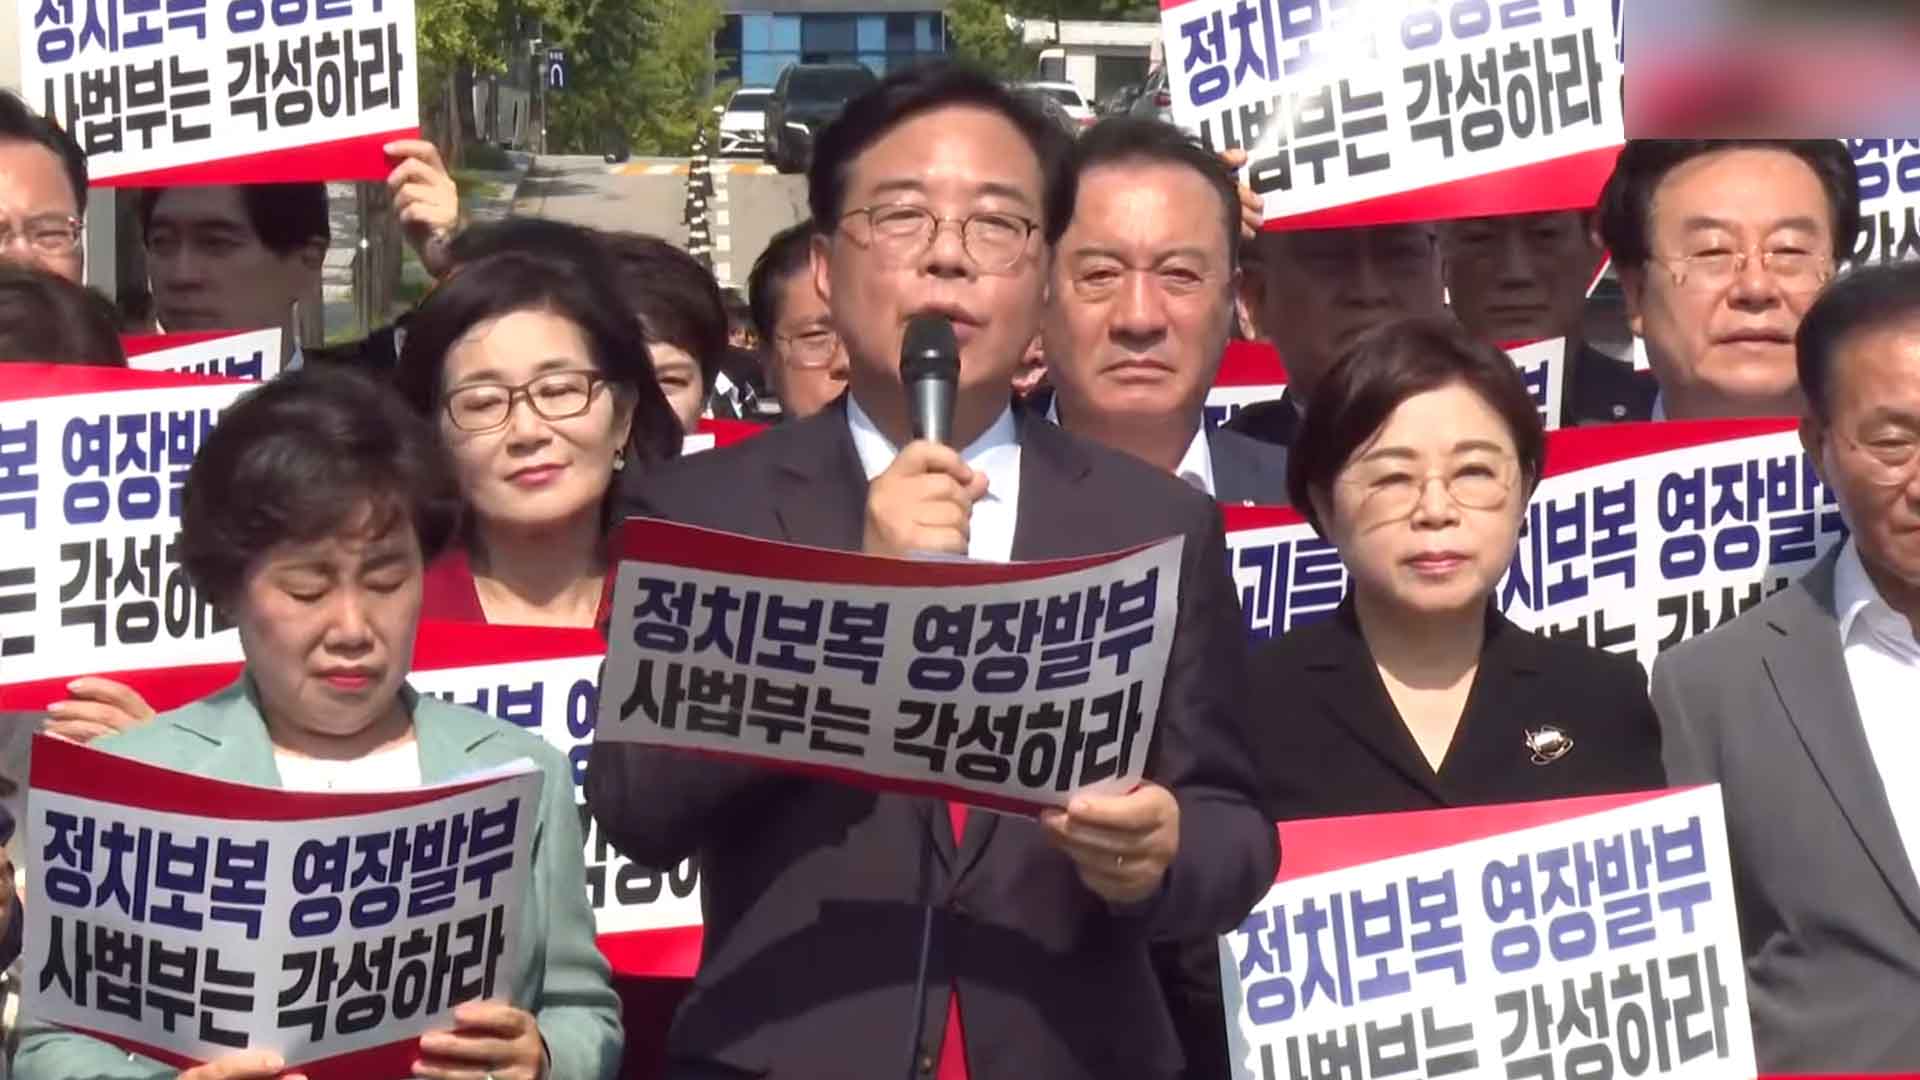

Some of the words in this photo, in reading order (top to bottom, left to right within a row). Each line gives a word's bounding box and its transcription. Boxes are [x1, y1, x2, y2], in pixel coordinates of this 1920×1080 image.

[226, 23, 403, 132] 각성하라
[1180, 0, 1378, 107] 정치보
[1402, 27, 1603, 158] 각성하라
[632, 577, 890, 685] 정치보복
[907, 567, 1159, 693] 영장발부
[619, 659, 871, 758] 사법부는
[893, 681, 1144, 791] 각성하라
[43, 810, 269, 940] 정치보복
[289, 797, 519, 938] 영장발부
[1238, 869, 1467, 1026] 정치보복
[1481, 816, 1712, 975] 영장발부
[40, 915, 256, 1048] 사법부는
[277, 904, 504, 1042] 각성하라
[1494, 944, 1730, 1080] 각성하라
